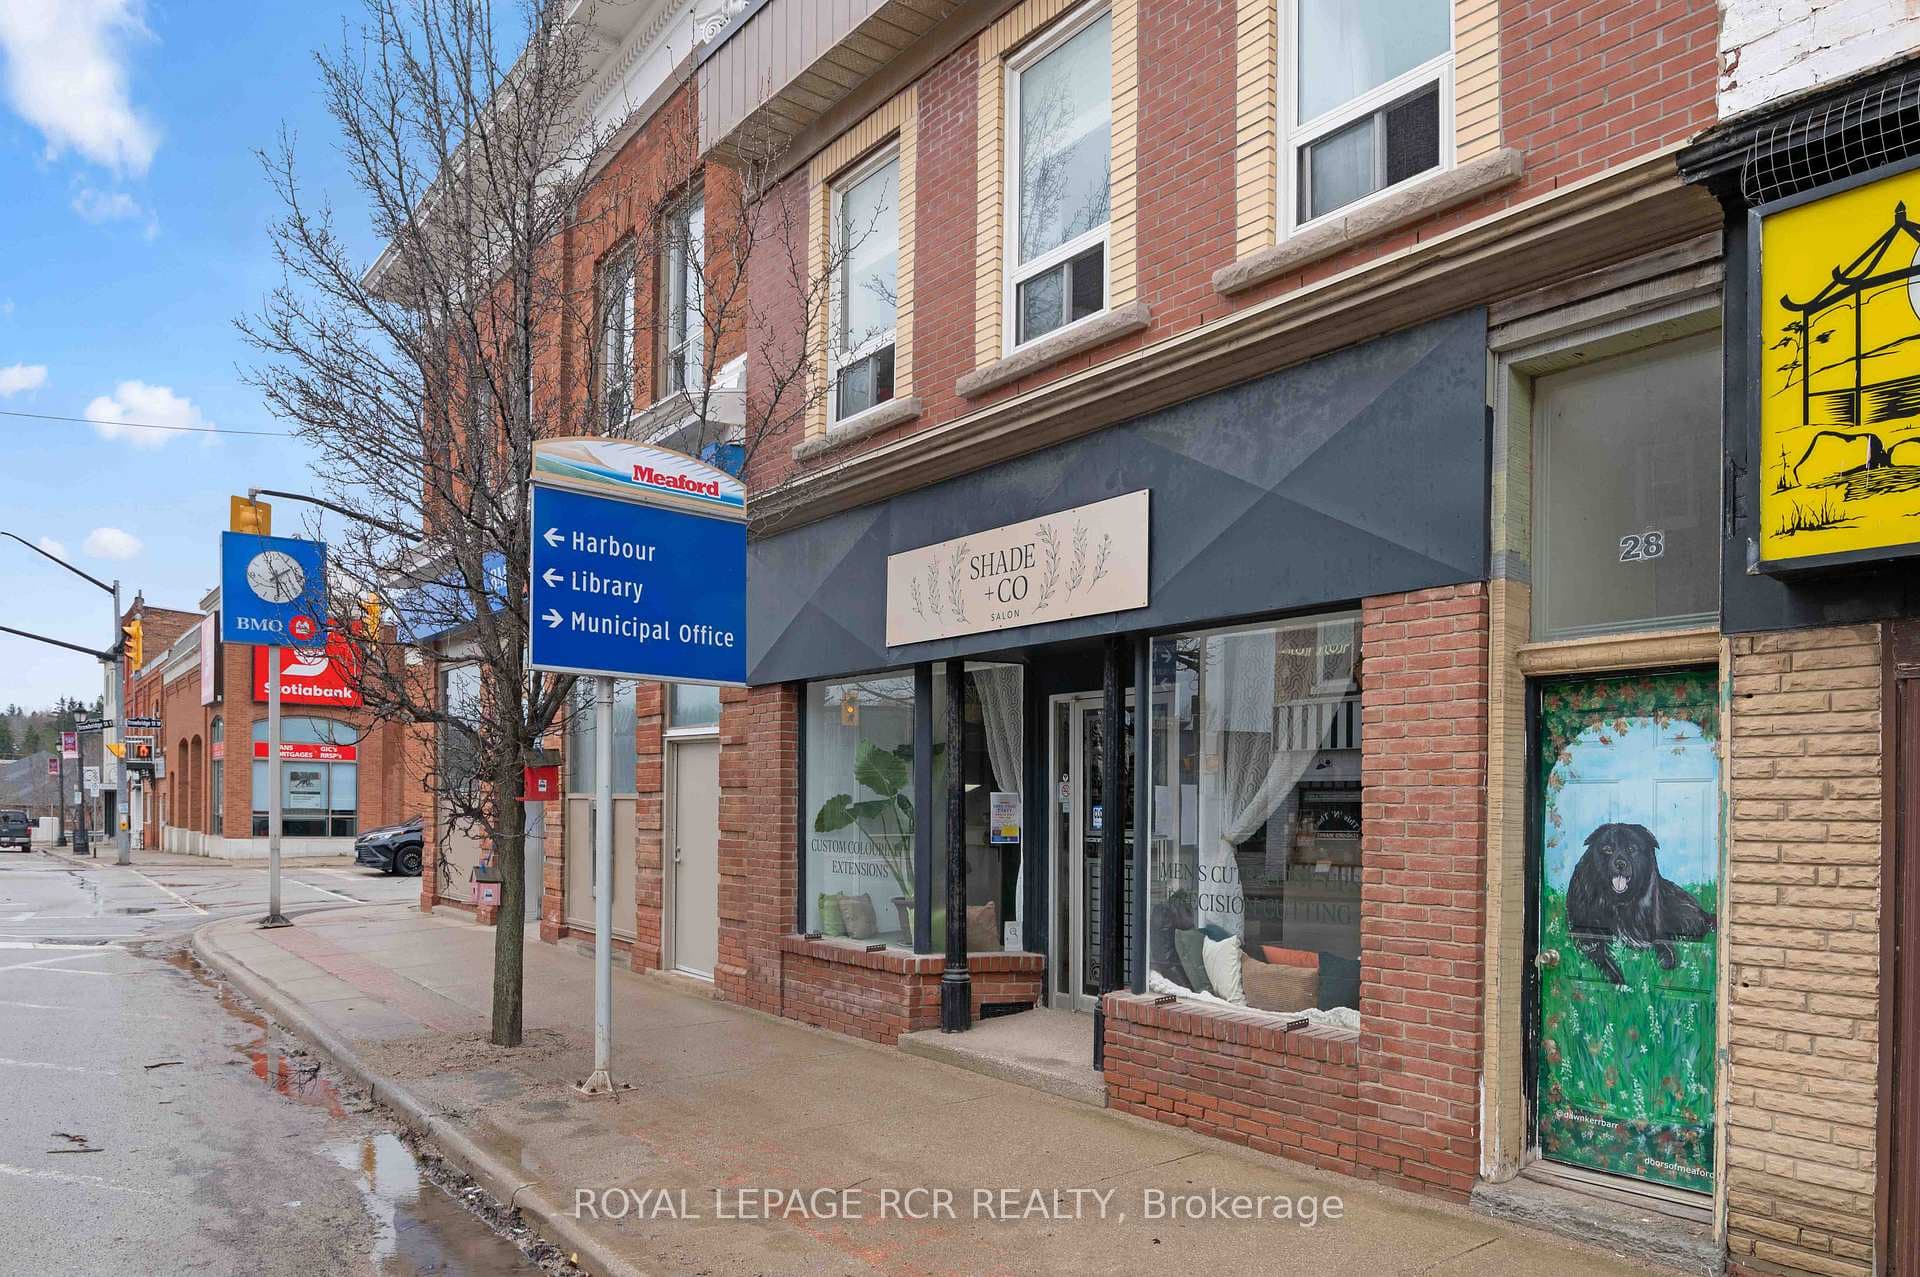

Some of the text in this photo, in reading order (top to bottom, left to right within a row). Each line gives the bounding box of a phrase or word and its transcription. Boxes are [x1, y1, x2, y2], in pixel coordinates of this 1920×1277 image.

[633, 465, 720, 497] Meaford
[572, 531, 656, 562] Harbour
[1619, 531, 1664, 561] 28
[970, 543, 1036, 580] SHADE
[571, 571, 643, 604] Library
[984, 575, 1029, 603] +CO
[236, 616, 283, 632] BMO
[571, 611, 734, 648] Municipal Office
[991, 609, 1020, 622] SALON
[264, 682, 352, 699] Sotiabank
[811, 839, 847, 854] CUSTOM
[832, 860, 889, 879] EXTENSIONS
